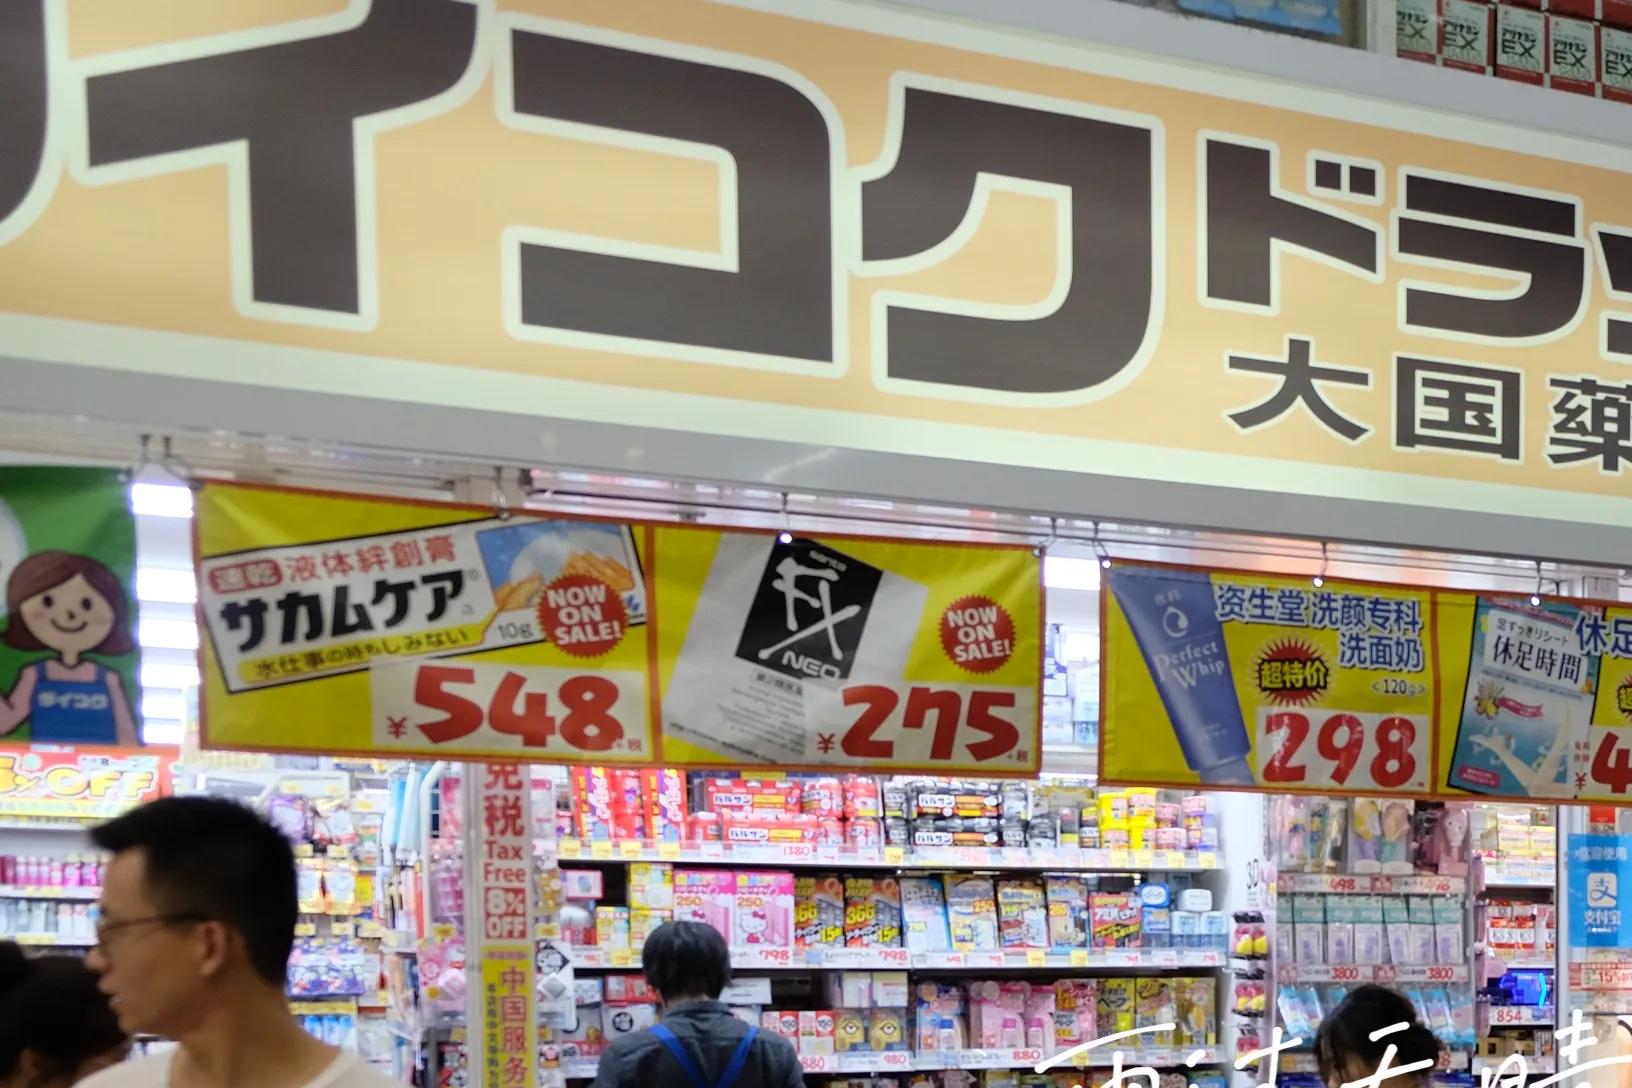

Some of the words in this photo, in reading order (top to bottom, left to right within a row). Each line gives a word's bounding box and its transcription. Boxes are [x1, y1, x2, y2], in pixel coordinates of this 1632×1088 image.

[285, 535, 457, 582] 液体絆創膏
[547, 585, 606, 607] NOW
[757, 556, 861, 661] FX
[1217, 586, 1305, 622] 资生堂
[221, 571, 463, 652] サカムケア
[559, 605, 603, 624] ON
[948, 606, 998, 627] NOW
[555, 621, 622, 645] SALE!
[958, 625, 996, 643] ON
[955, 642, 1011, 662] SALE!
[1154, 641, 1218, 682] Perfect
[1340, 633, 1421, 670] 洗面奶
[1493, 635, 1582, 684] 休足時間
[783, 652, 841, 681] NEO
[1171, 660, 1225, 690] Whip
[1260, 660, 1327, 689] 超特价
[1263, 712, 1416, 787] 298
[485, 841, 523, 859] Tax
[484, 863, 526, 882] Free
[487, 889, 525, 914] 8%
[486, 918, 525, 937] OFF
[1584, 910, 1621, 925] 支付宝
[1496, 1010, 1522, 1022] 854
